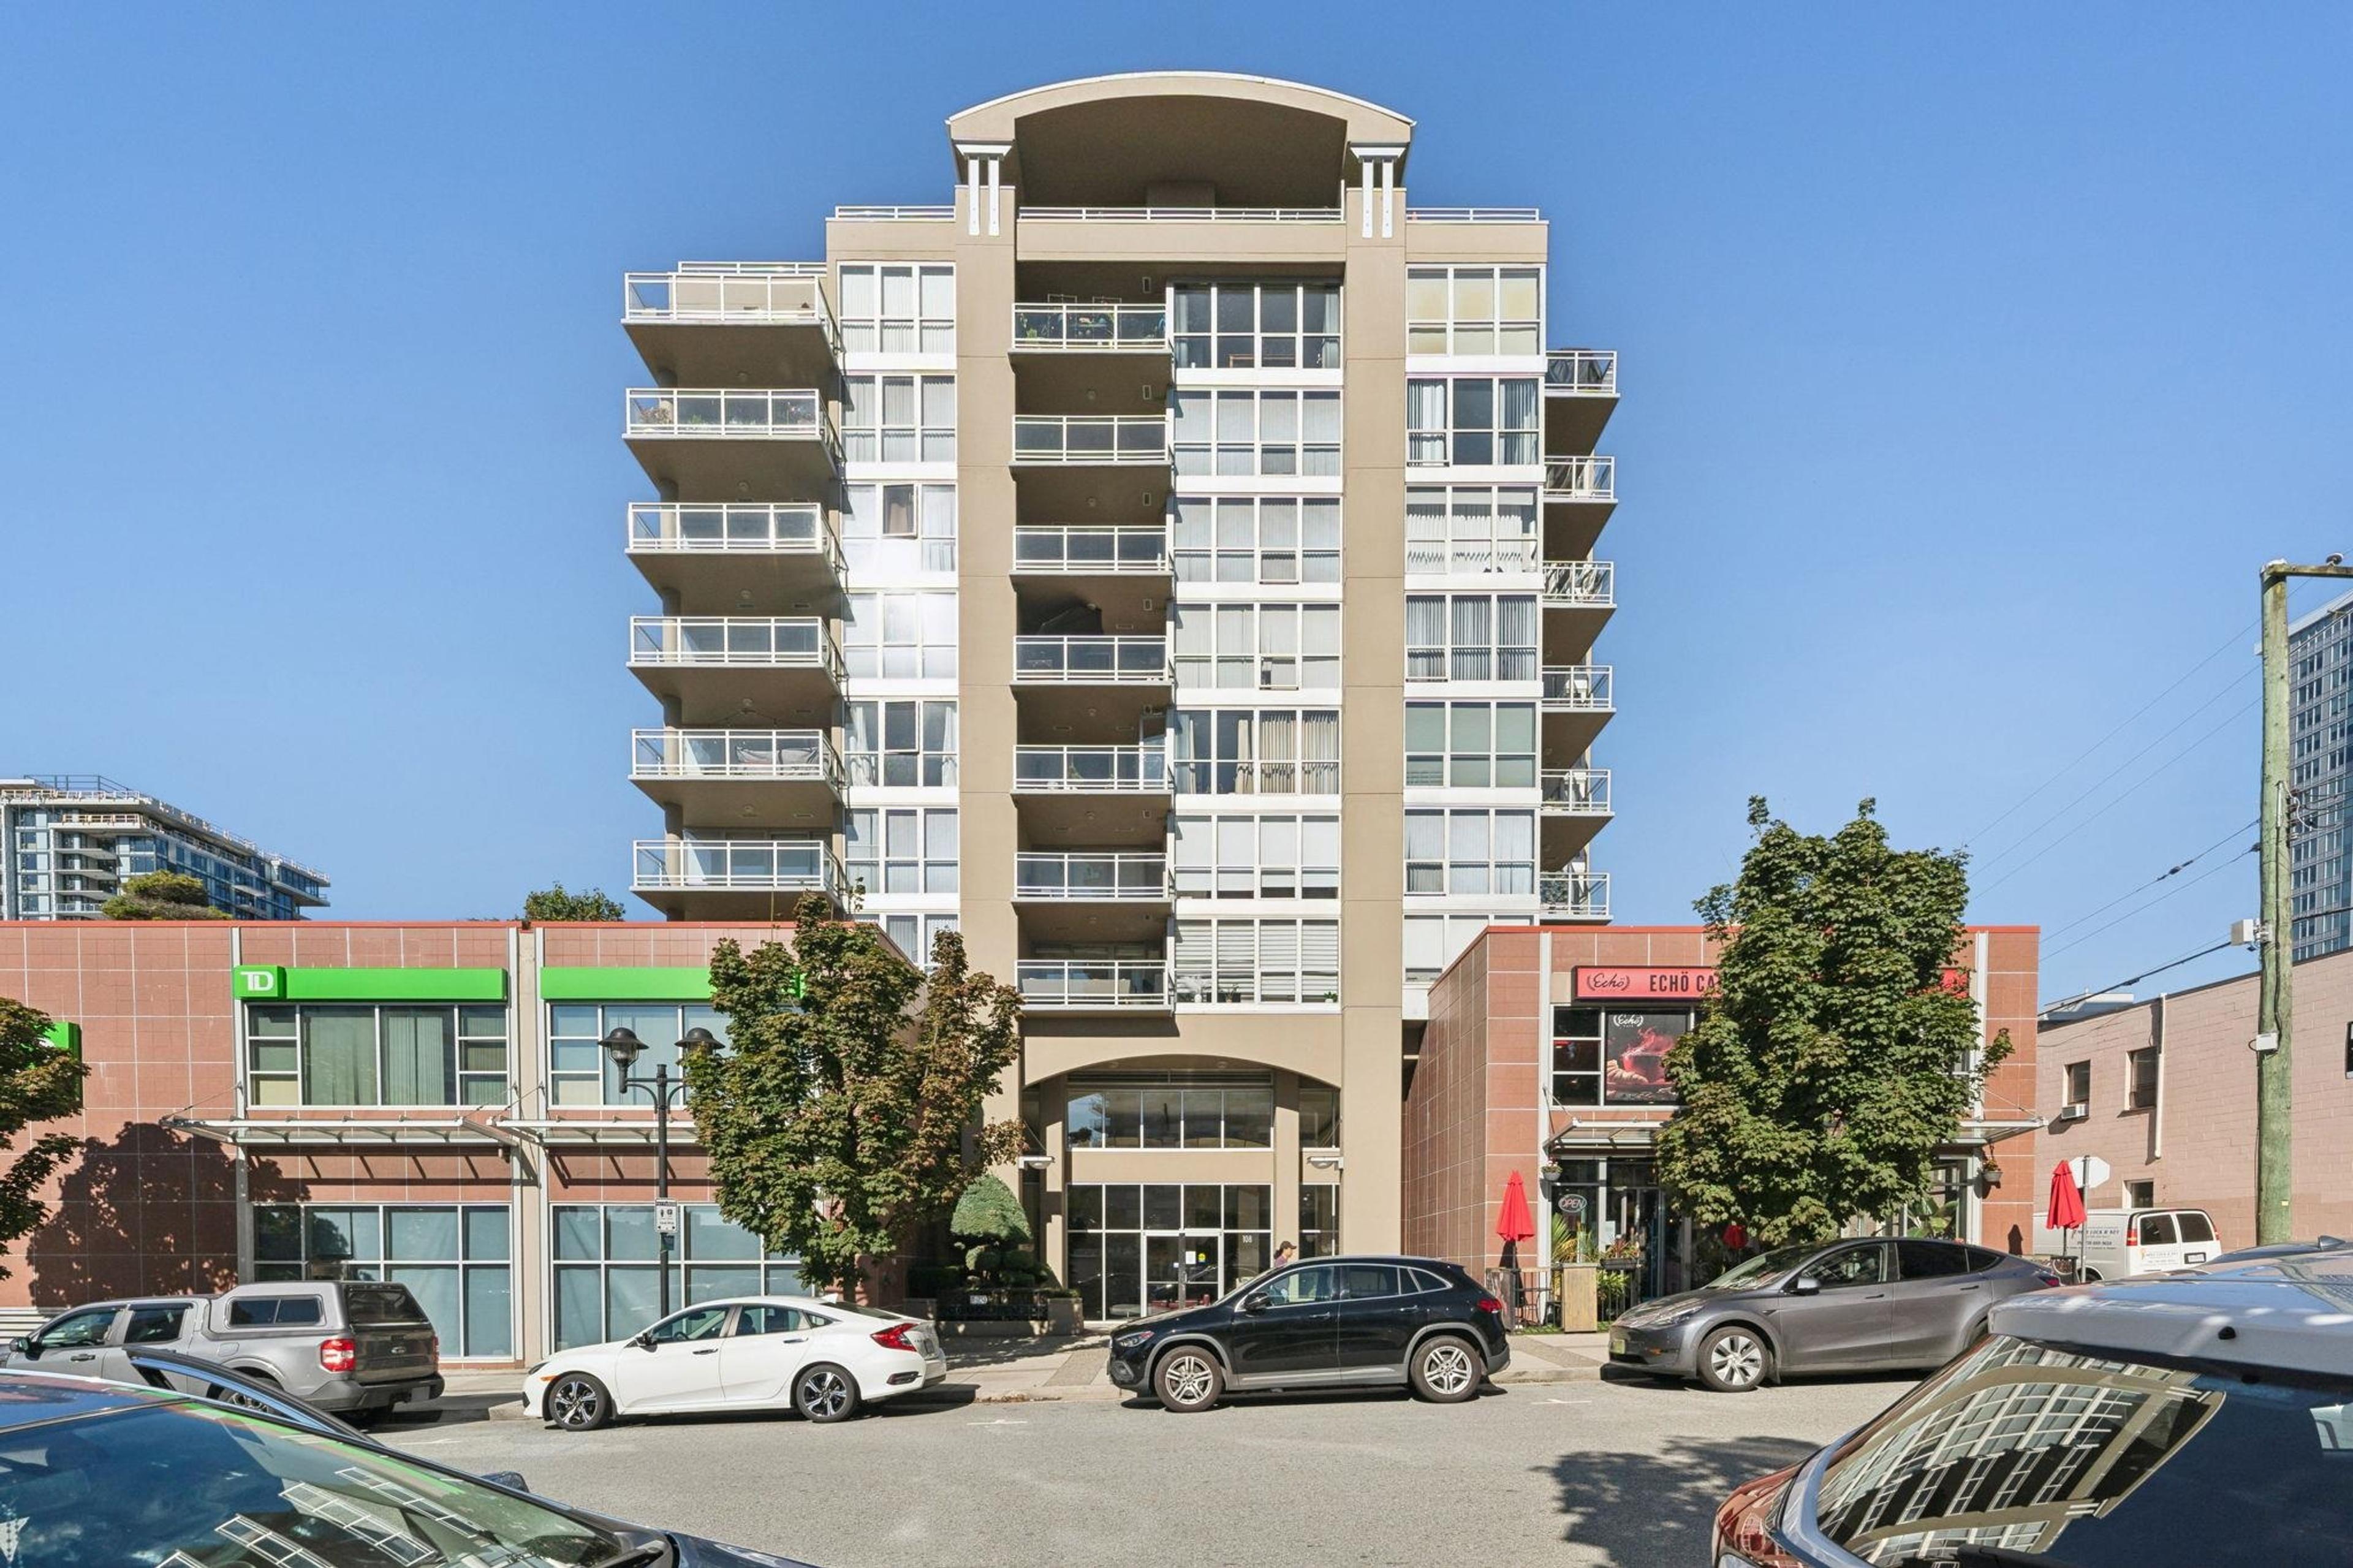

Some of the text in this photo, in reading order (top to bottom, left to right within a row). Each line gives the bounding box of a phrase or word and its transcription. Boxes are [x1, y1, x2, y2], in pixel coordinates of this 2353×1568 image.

[241, 971, 273, 991] TD
[1650, 971, 1716, 992] ECHÖ CA
[1560, 1197, 1583, 1208] OPEN
